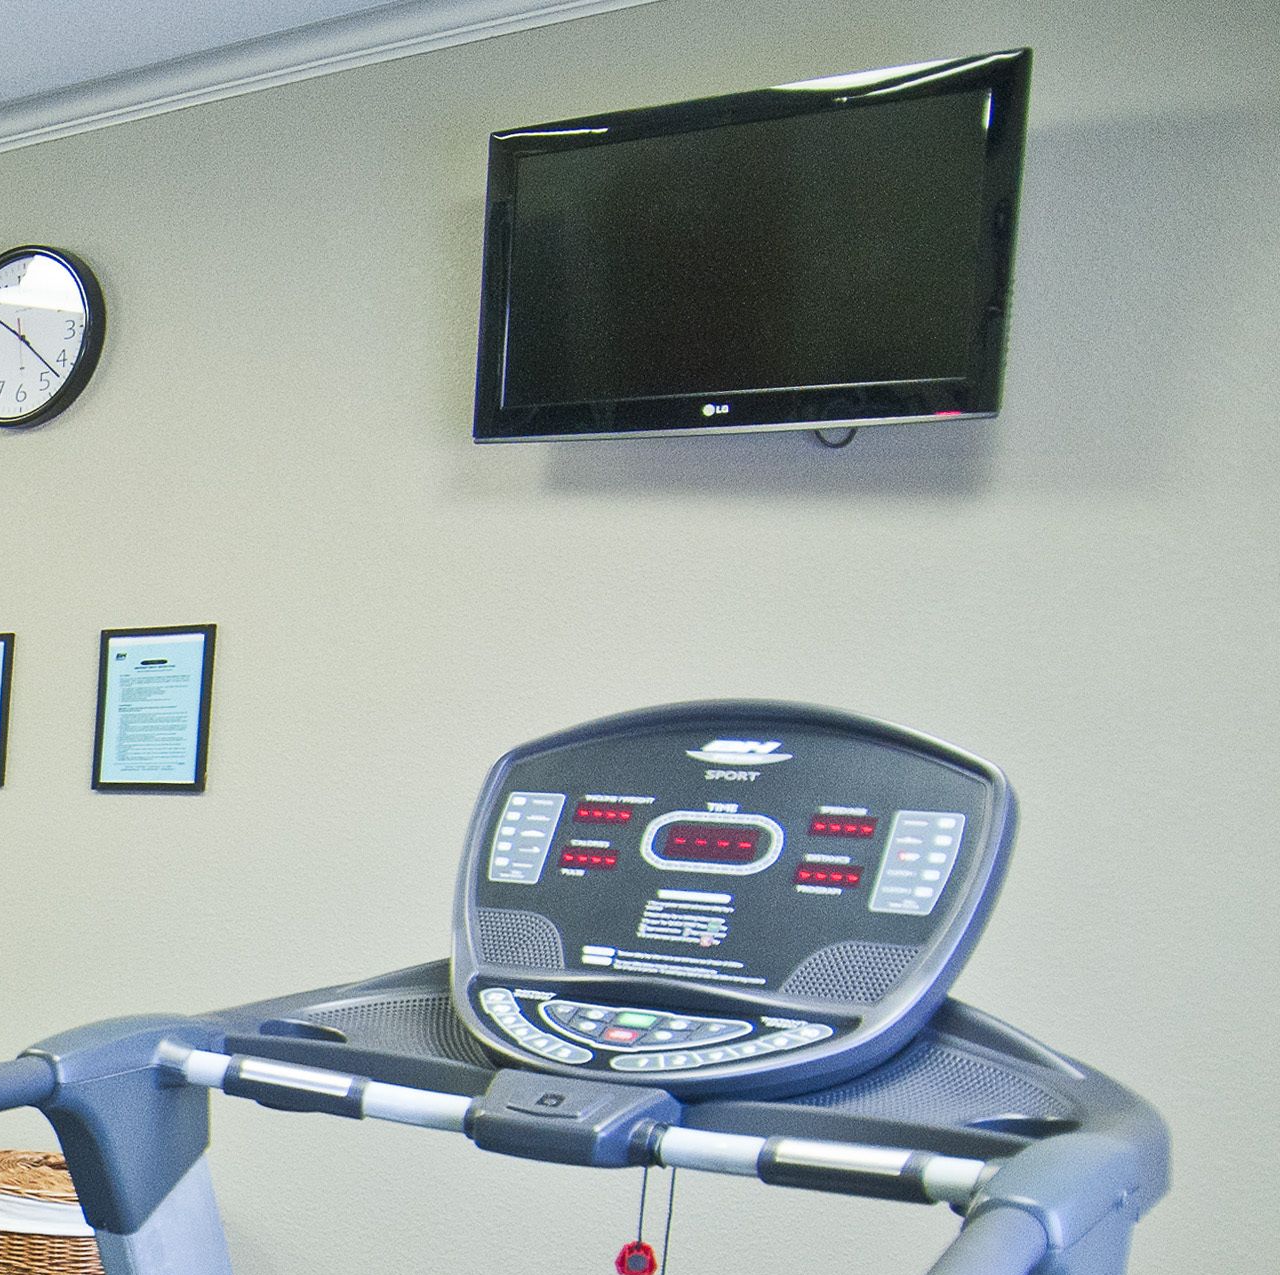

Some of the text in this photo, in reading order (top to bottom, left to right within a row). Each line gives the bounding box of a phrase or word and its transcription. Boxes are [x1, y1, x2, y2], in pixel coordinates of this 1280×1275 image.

[63, 319, 76, 340] 3
[55, 348, 68, 368] 4
[39, 370, 51, 391] 5
[15, 383, 28, 403] 6
[704, 769, 761, 782] SPORT
[706, 801, 739, 813] TIME
